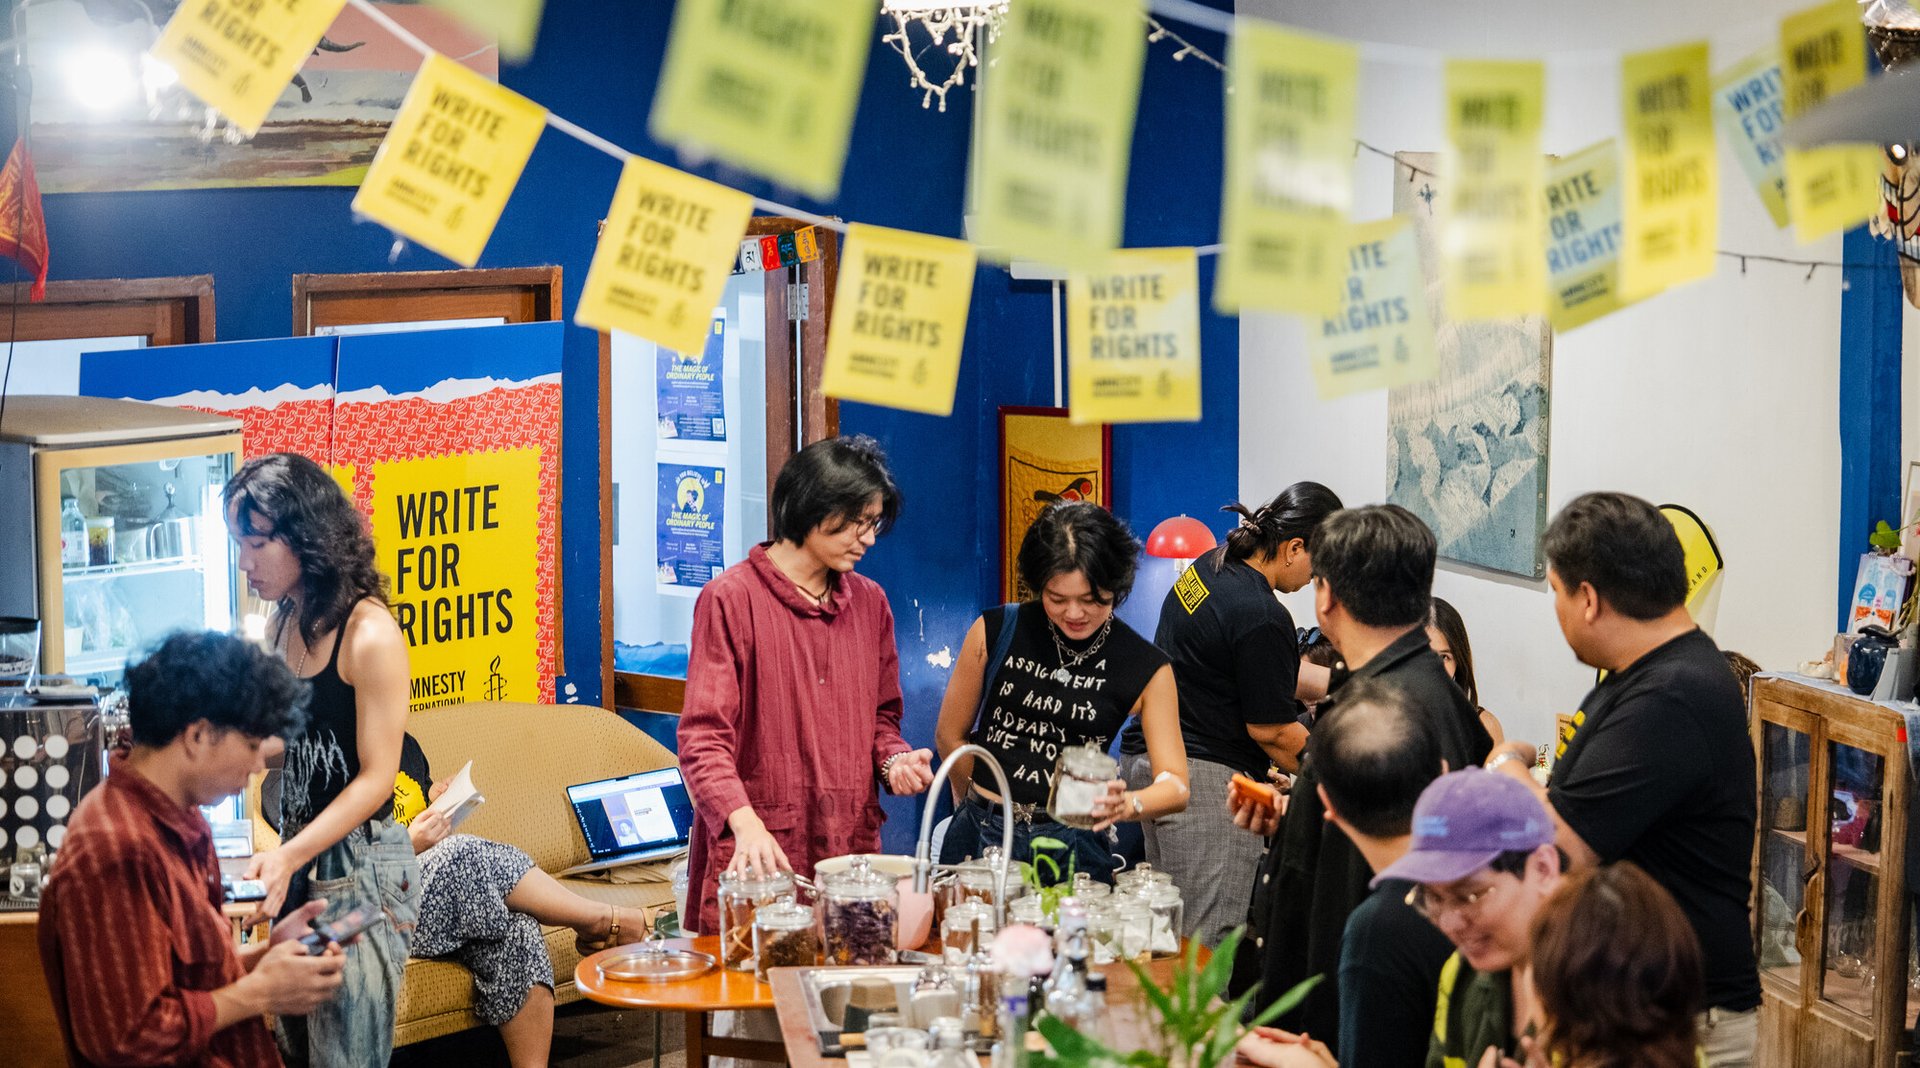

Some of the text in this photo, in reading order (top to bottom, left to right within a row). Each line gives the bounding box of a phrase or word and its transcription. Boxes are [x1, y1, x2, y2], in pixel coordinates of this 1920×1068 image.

[434, 84, 507, 140] WRITE
[416, 112, 466, 151] FOR
[402, 140, 491, 199] RIGHTS
[1546, 171, 1600, 209] RITE
[638, 188, 714, 233] WRITE
[1551, 210, 1584, 240] OR
[627, 214, 676, 250] FOR
[616, 243, 705, 294] RIGHTS
[865, 253, 940, 289] WRITE
[1349, 240, 1387, 272] ITE
[858, 281, 907, 310] FOR
[1089, 274, 1165, 301] WRITE
[853, 310, 941, 348] RIGHTS
[1090, 305, 1136, 330] FOR
[1090, 334, 1178, 360] RIGHTS
[397, 484, 499, 540] WRITE
[397, 543, 460, 595] FOR
[1690, 566, 1708, 591] AND
[398, 588, 513, 647] RIGHTS
[410, 670, 465, 700] MNESTY
[1005, 656, 1106, 691] ASSIGNENT
[409, 696, 464, 712] TERNATIONAL
[1000, 681, 1097, 721] IS HARD IT'S
[987, 725, 1018, 749] ONE
[1013, 765, 1055, 787] HAV
[394, 803, 405, 819] OR
